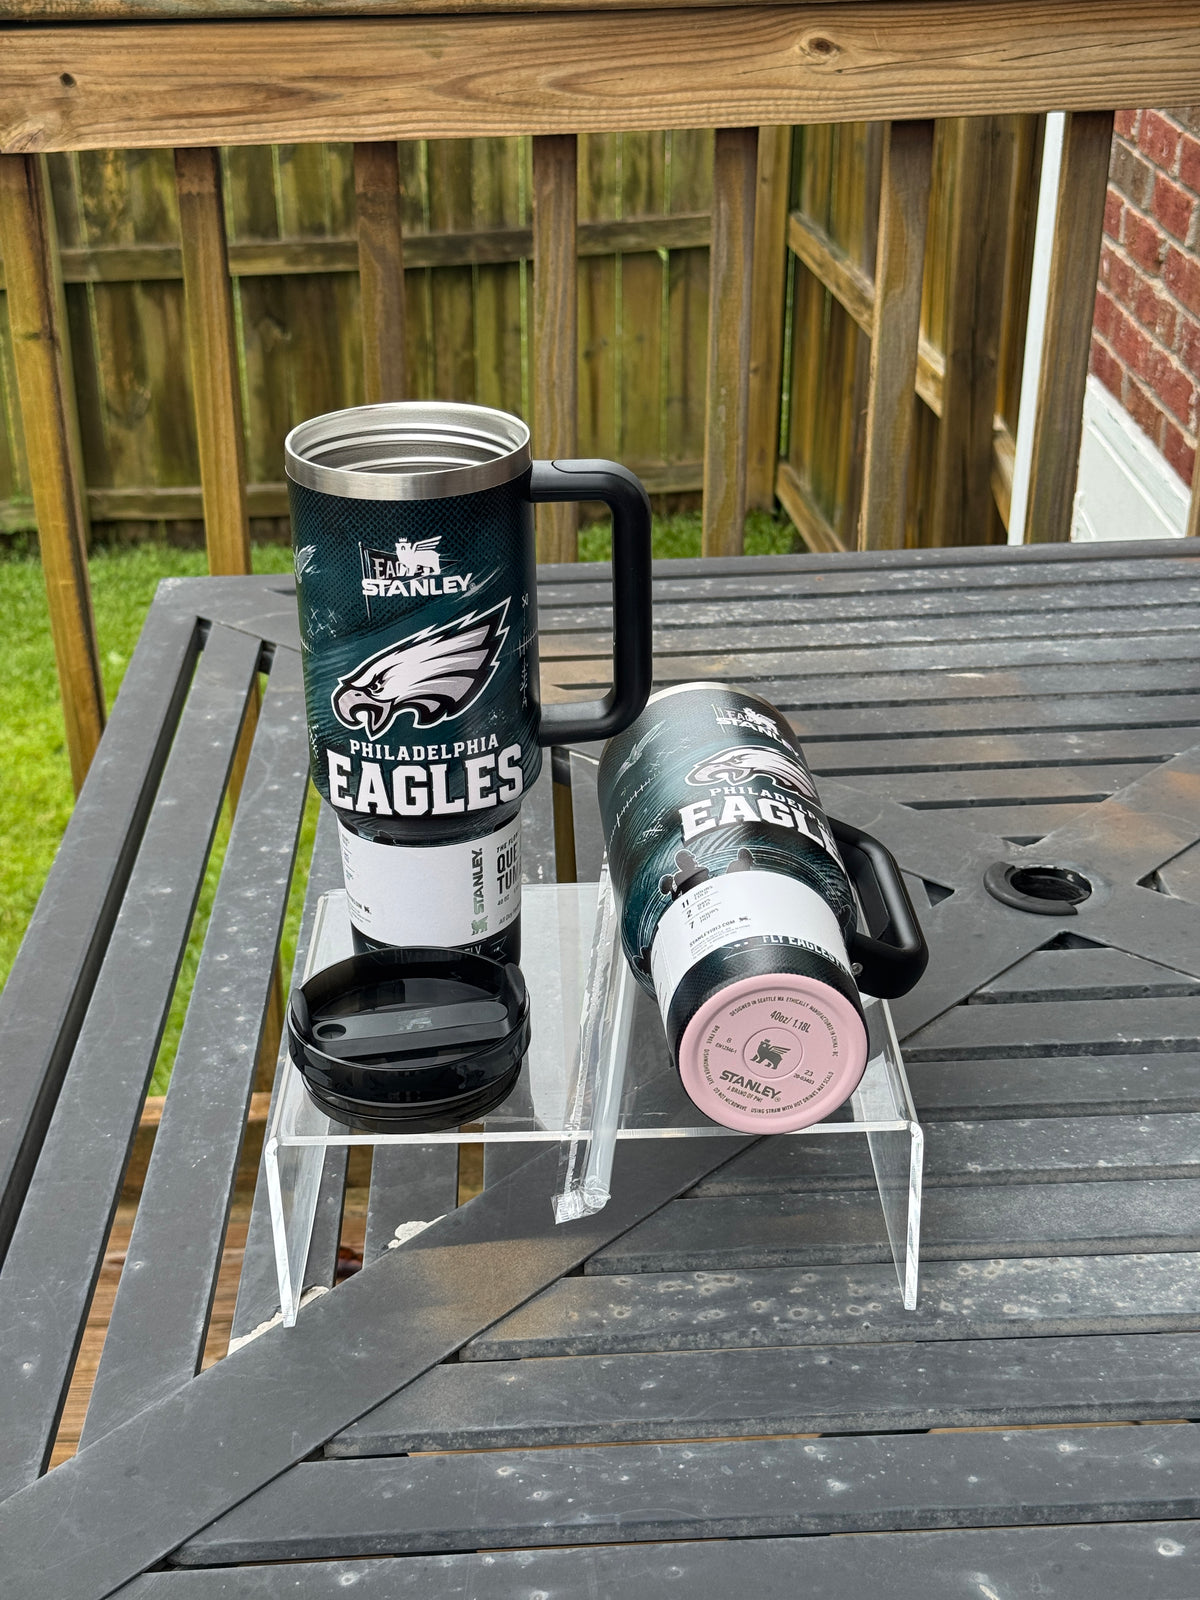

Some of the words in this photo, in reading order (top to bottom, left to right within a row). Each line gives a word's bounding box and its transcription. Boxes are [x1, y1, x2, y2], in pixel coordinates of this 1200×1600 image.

[361, 573, 473, 597] STANLEY
[350, 734, 499, 761] PHILADELPHIA
[326, 743, 524, 816] EAGLES
[496, 843, 507, 853] THE
[471, 848, 485, 915] STANLEY
[681, 899, 690, 908] 11
[686, 909, 693, 918] 2
[689, 921, 695, 929] 7
[762, 935, 784, 944] FLY
[788, 936, 835, 962] EAGLES
[729, 1001, 751, 1016] DESIGNED
[757, 996, 777, 1004] SEATTLE
[786, 996, 809, 1008] ETHICALLY
[809, 1005, 834, 1031] MANUFACTURED
[792, 1019, 811, 1033] 1.18L
[804, 1069, 814, 1077] 23
[719, 1069, 782, 1099] STANLEY
[730, 1086, 747, 1097] BRAND
[816, 1083, 825, 1092] MAY
[718, 1091, 726, 1100] NOT
[724, 1096, 747, 1112] MICROWAVE
